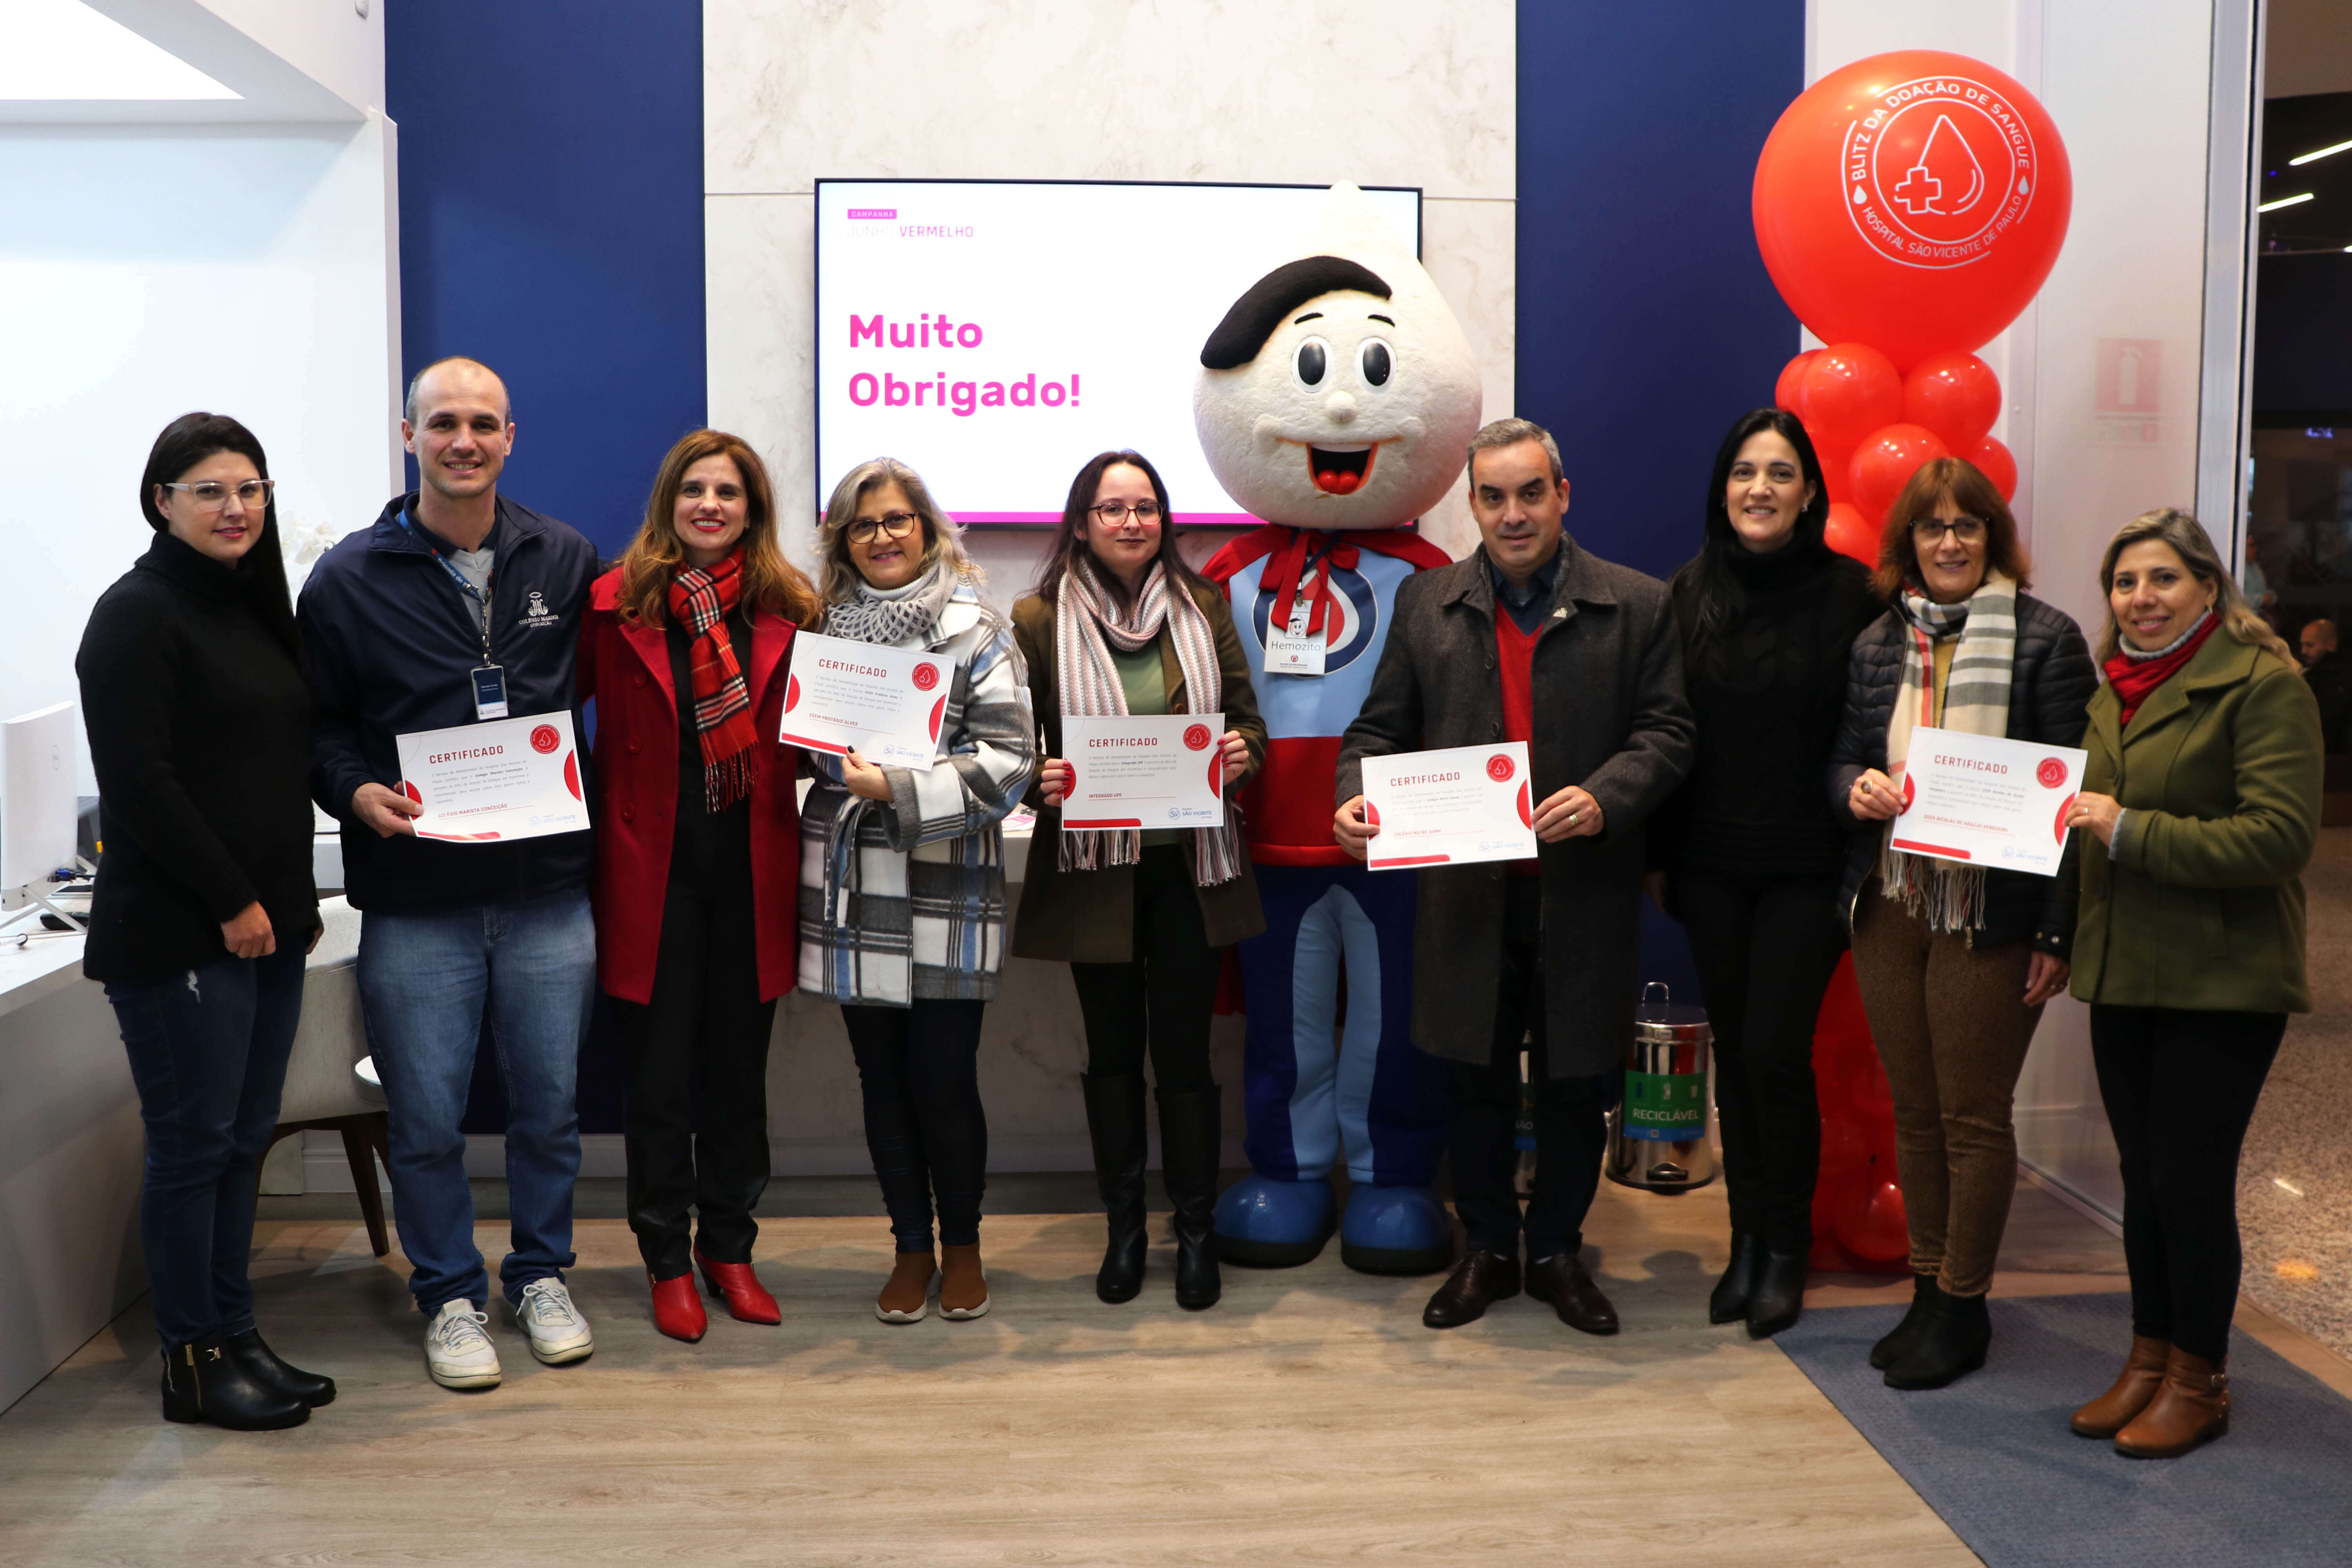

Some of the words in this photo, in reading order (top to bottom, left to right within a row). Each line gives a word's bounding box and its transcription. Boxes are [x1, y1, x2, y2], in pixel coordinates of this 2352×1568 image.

[1851, 133, 1871, 181] BLITZ
[1864, 107, 1888, 129] DA
[1885, 80, 1960, 109] DOAÇÃO
[1965, 87, 1989, 105] DE
[1990, 103, 2030, 169] SANGUE
[899, 225, 973, 238] VERMELHO
[1862, 206, 1904, 250] HOSPITAL
[1908, 242, 1931, 256] SÃO
[1933, 241, 1982, 258] VICENTE
[1984, 230, 1998, 247] DE
[1996, 195, 2022, 233] PAULO
[849, 313, 983, 348] Muito
[848, 372, 1080, 417] Obrigado!
[1271, 641, 1321, 652] Hemozito
[819, 659, 887, 678] CERTIFICADO
[822, 715, 844, 724] PROTÁSIO
[1089, 737, 1158, 748] CERTIFICADO
[429, 745, 504, 764] CERTIFICADO
[1935, 755, 2008, 774] CERTIFICADO
[1390, 772, 1460, 787] CERTIFICADO
[481, 803, 508, 812] CONCEIÇÃO
[1633, 1108, 1699, 1121] RECICLÁVEL
